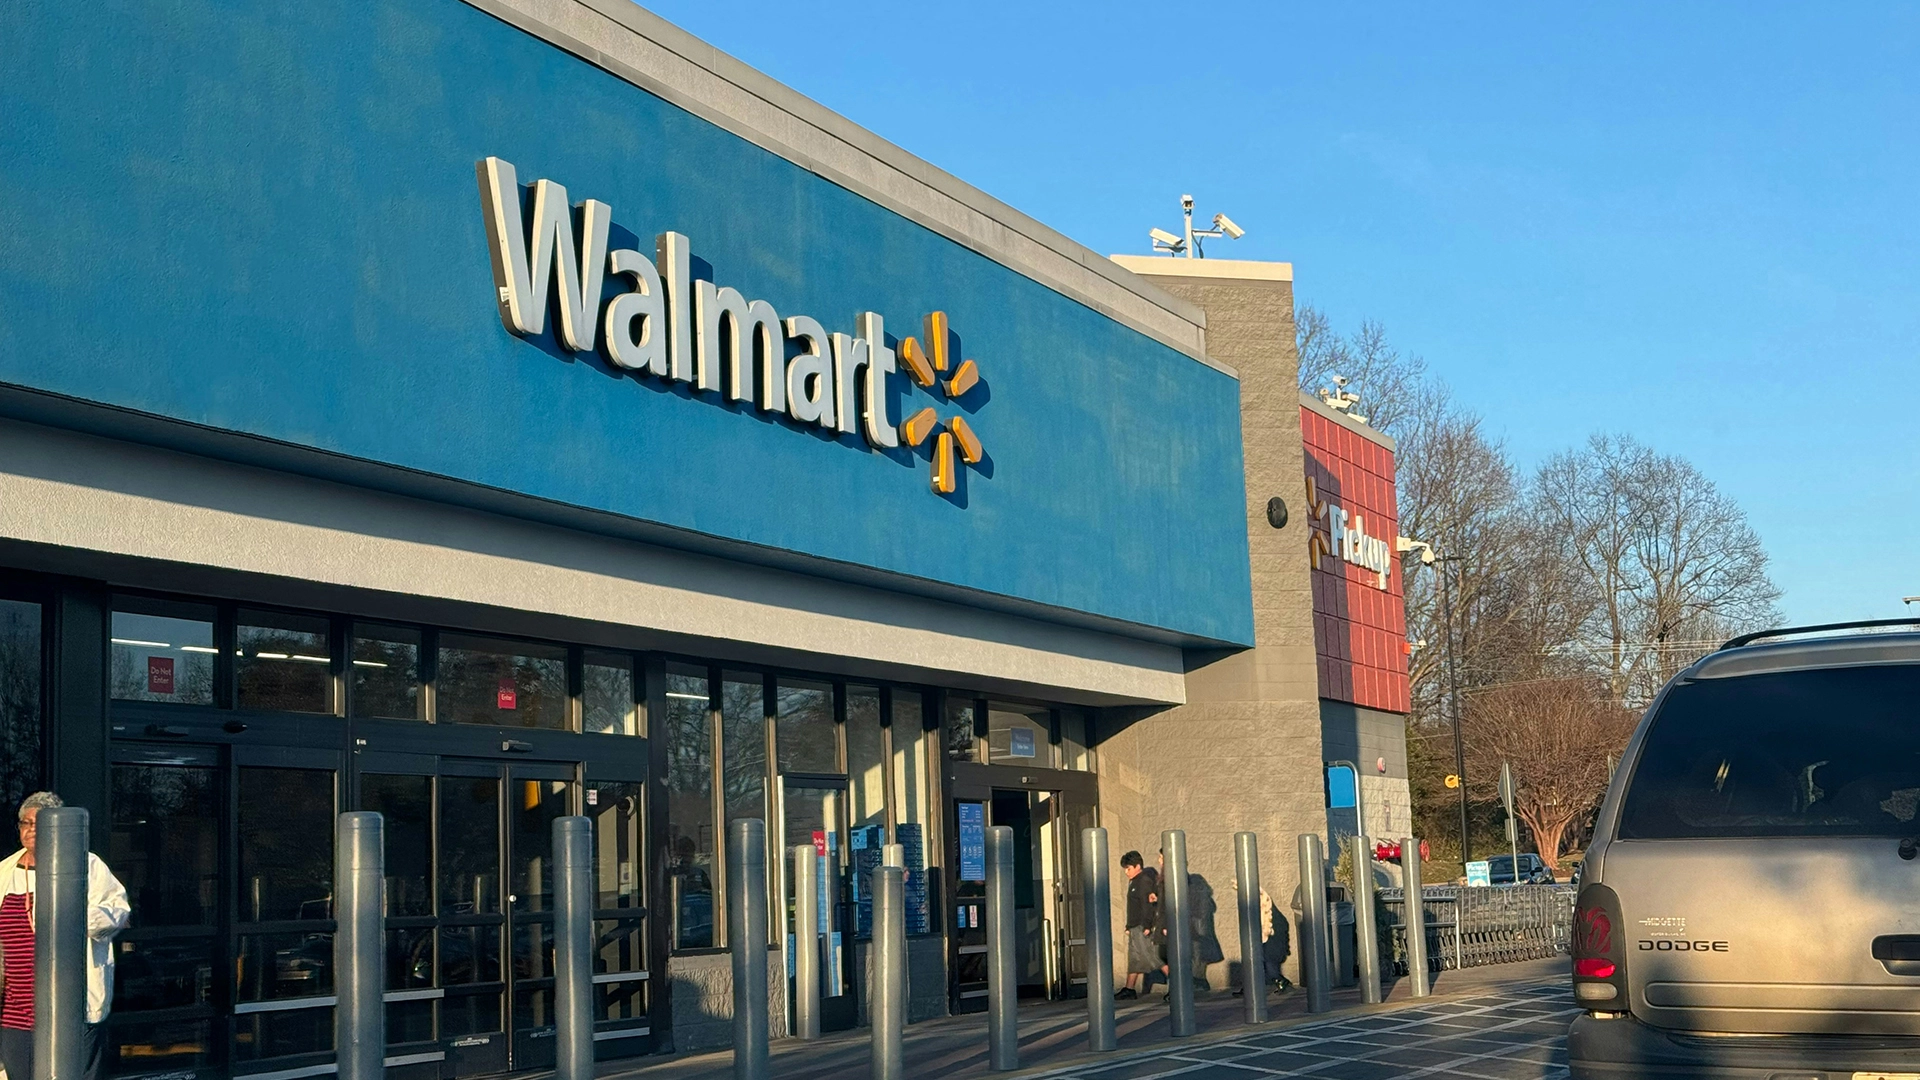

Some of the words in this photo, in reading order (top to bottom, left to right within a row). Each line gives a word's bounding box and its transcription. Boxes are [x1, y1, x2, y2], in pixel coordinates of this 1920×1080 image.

[476, 156, 898, 448] Walmart
[1329, 504, 1391, 590] Pickup
[150, 666, 159, 675] Do
[160, 667, 171, 676] Not
[153, 675, 169, 684] Enter
[1638, 940, 1729, 952] DODGE
